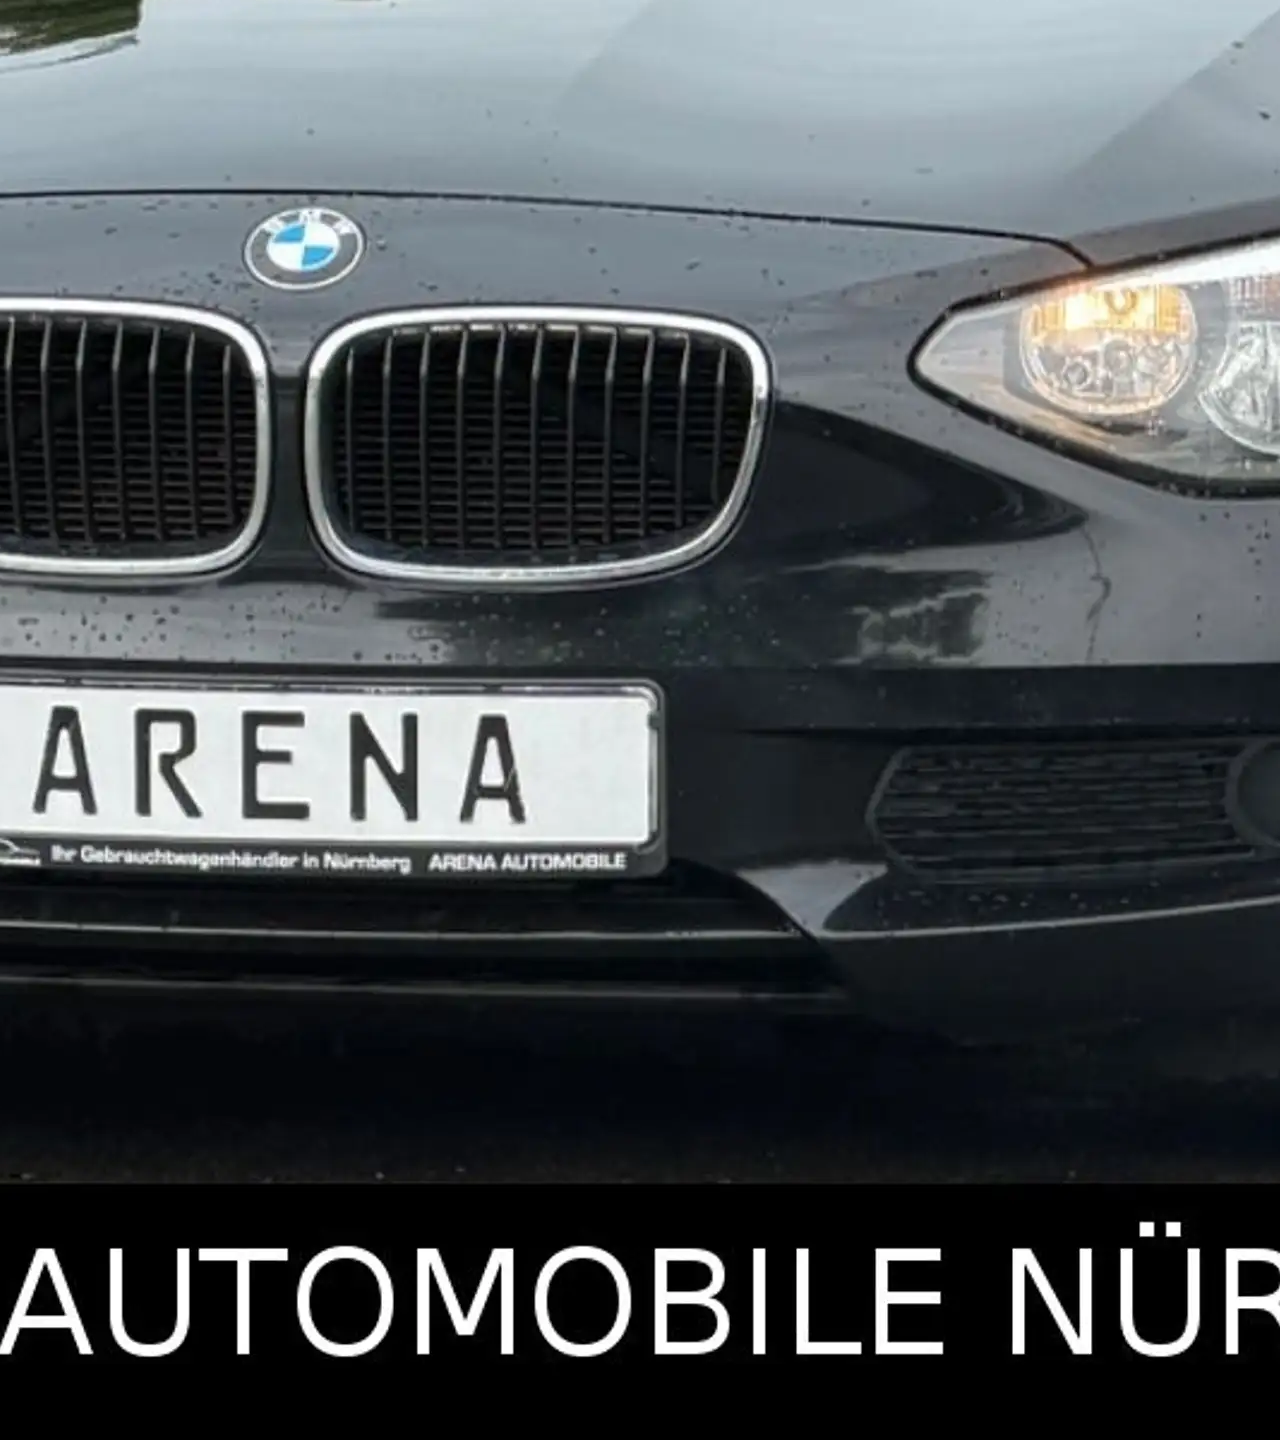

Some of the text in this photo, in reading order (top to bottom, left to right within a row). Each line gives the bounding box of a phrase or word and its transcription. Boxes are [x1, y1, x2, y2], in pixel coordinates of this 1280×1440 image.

[33, 705, 526, 824] ARENA
[51, 845, 77, 863] Ihr
[81, 845, 297, 871] Gebrauchtwagenhändler
[303, 851, 319, 869] in
[323, 851, 412, 876] Nürnberg
[428, 852, 497, 872] ARENA
[500, 851, 628, 872] AUTOMOBILE
